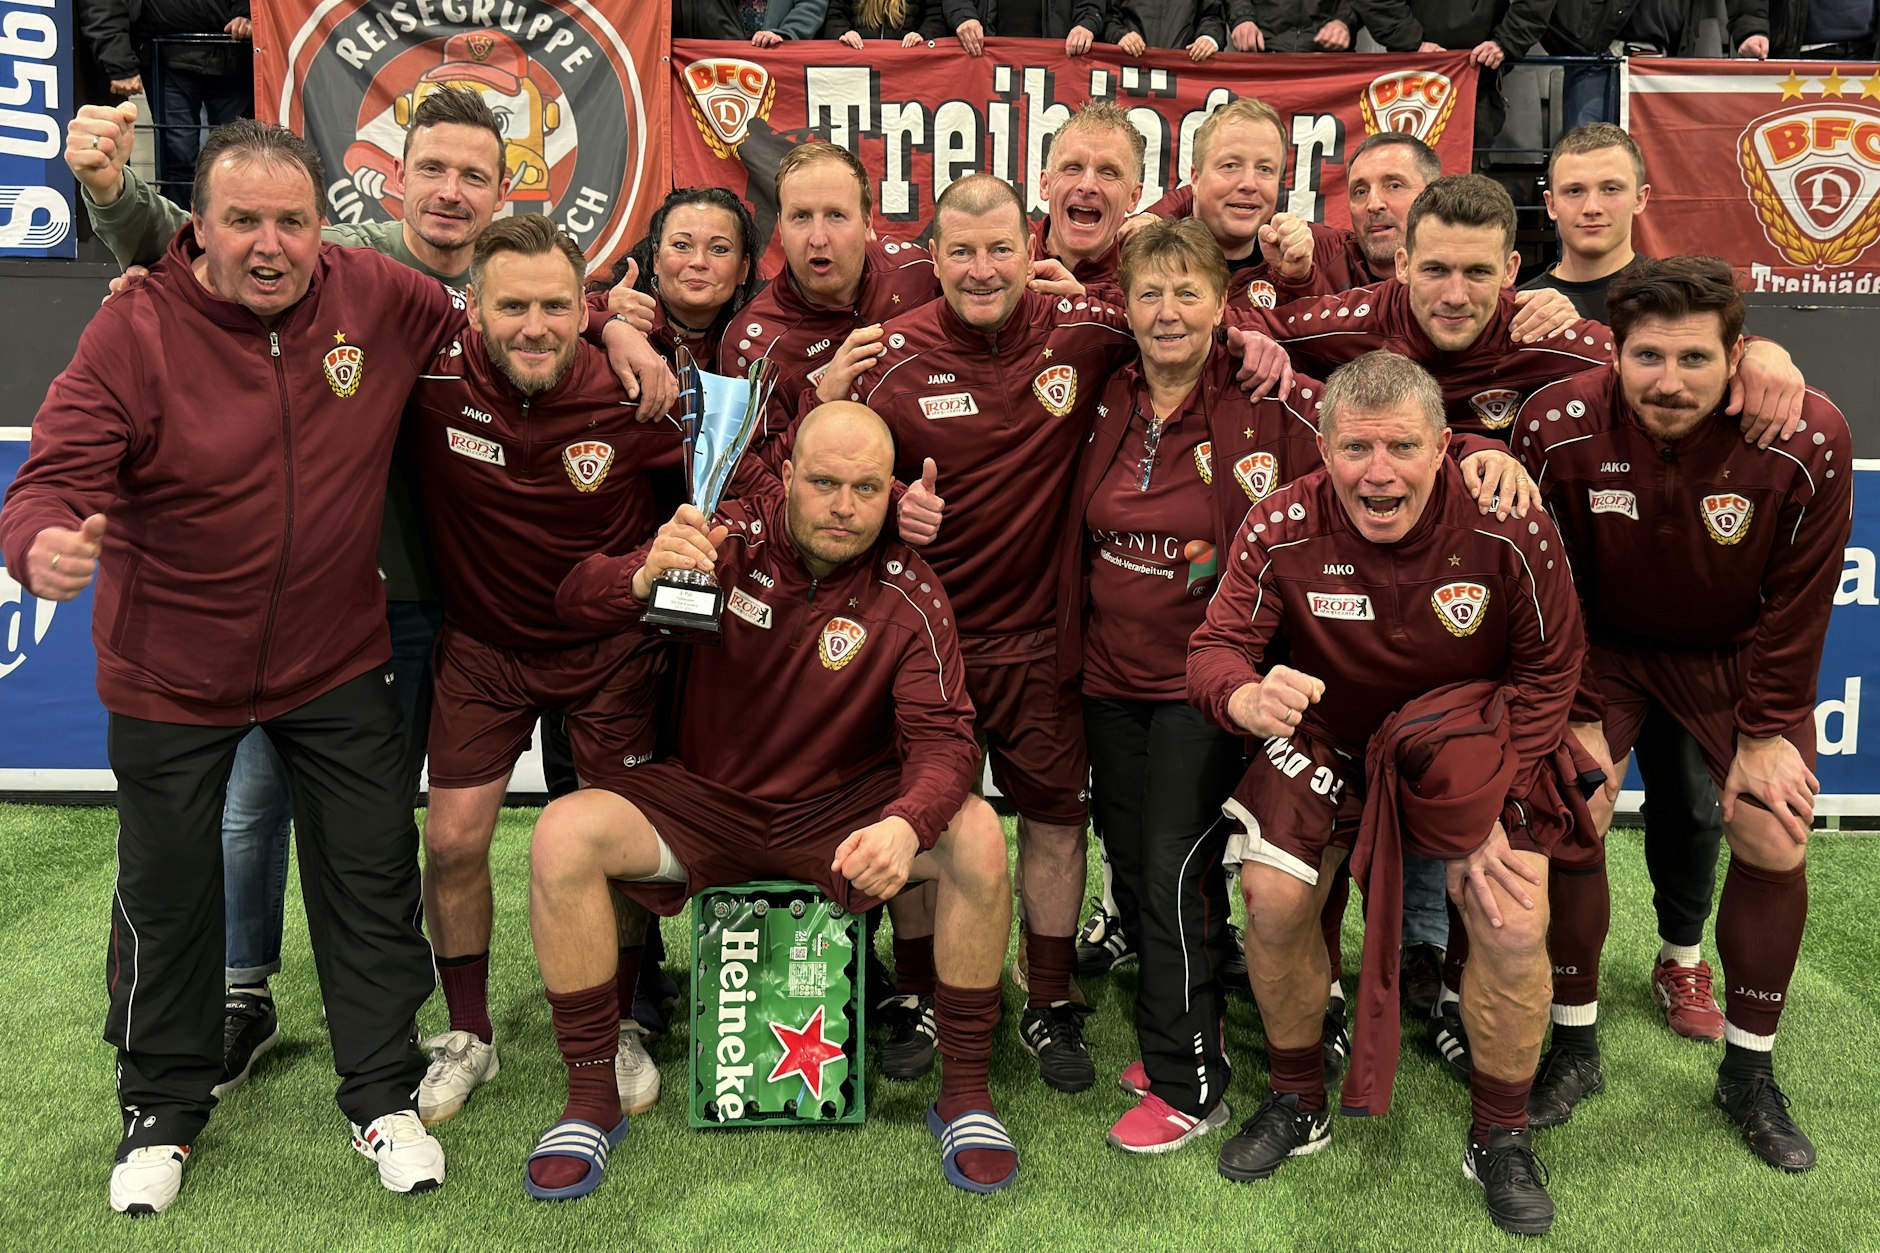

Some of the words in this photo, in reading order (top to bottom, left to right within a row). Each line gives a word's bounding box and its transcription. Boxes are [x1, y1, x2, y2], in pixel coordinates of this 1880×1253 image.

[335, 0, 592, 73] REISEGRUPPE
[0, 0, 61, 160] 950
[688, 64, 764, 95] BFC
[1373, 76, 1448, 107] BFC
[804, 65, 1340, 222] Treibär
[1762, 117, 1880, 164] BFC
[326, 348, 360, 366] BFC
[806, 338, 830, 357] JAKO
[927, 373, 956, 385] JAKO
[1036, 366, 1071, 387] BFC
[461, 405, 492, 424] JAKO
[568, 442, 610, 460] BFC
[1238, 455, 1272, 475] BFC
[1600, 462, 1630, 473] JAKO
[1704, 496, 1748, 513] BFC
[749, 569, 775, 589] JAKO
[1322, 564, 1355, 575] JAKO
[1438, 585, 1483, 605] BFC
[826, 619, 861, 641] BFC
[1735, 986, 1782, 1001] JAKO
